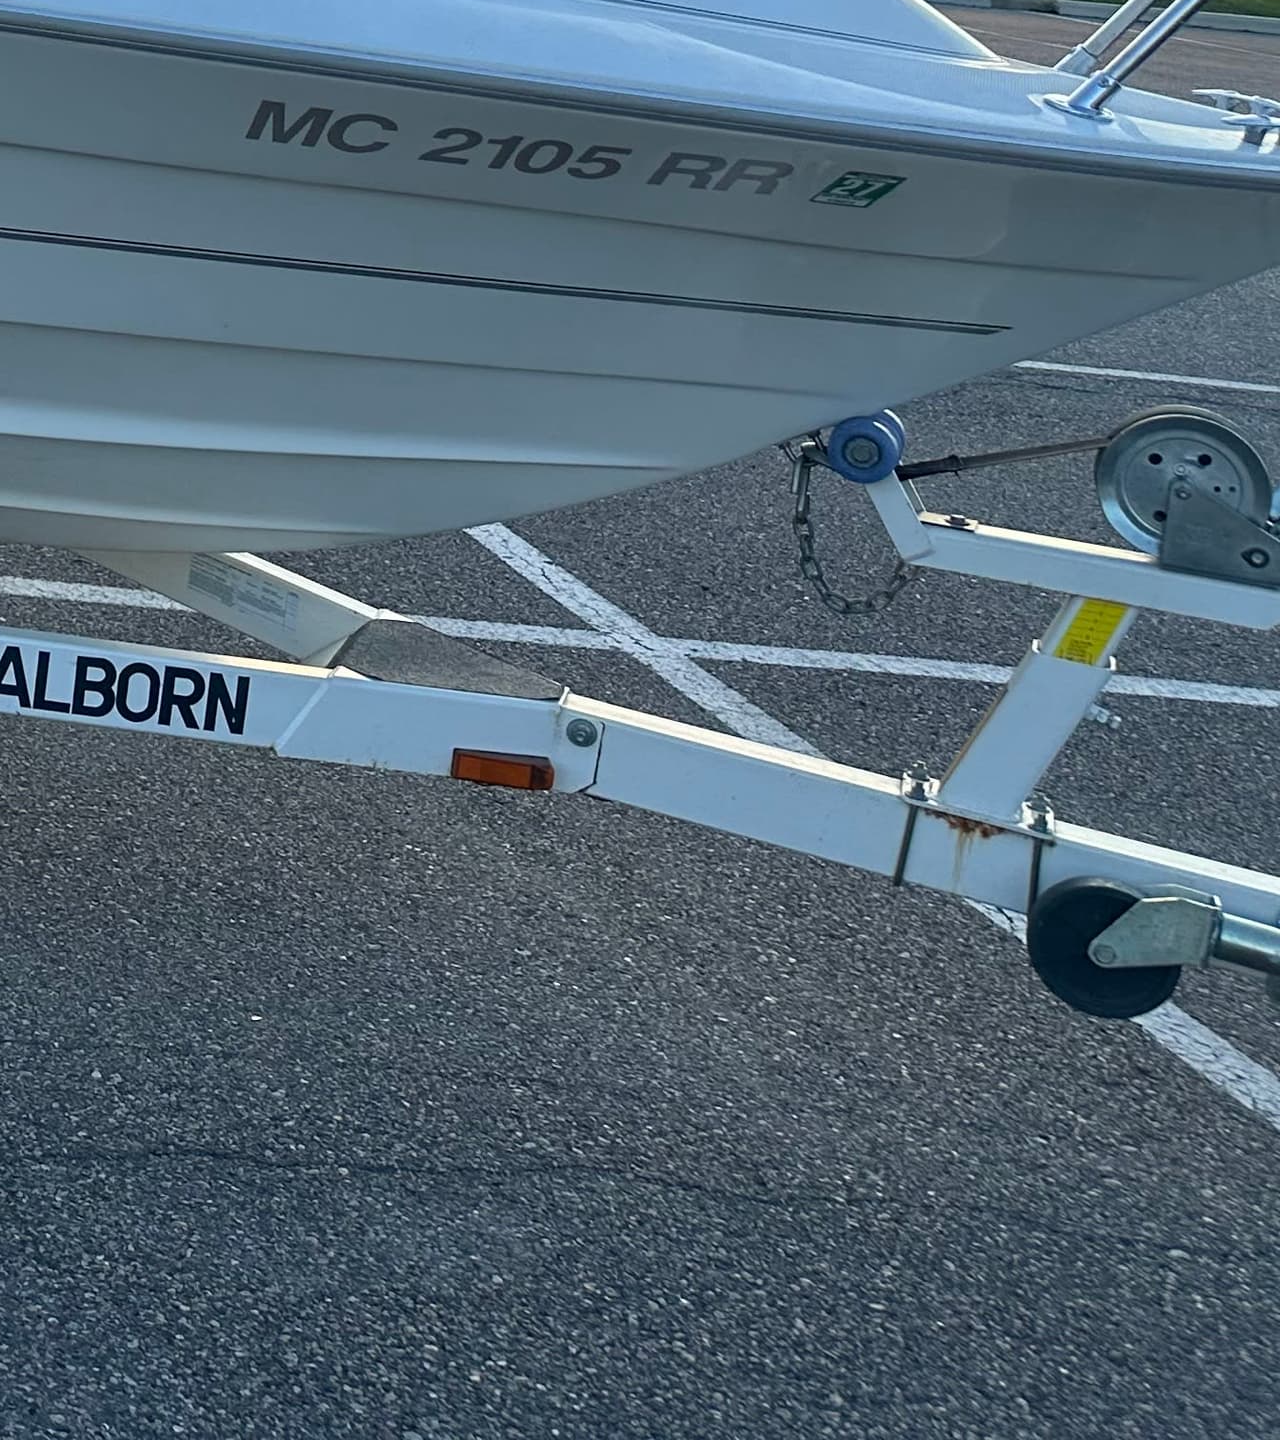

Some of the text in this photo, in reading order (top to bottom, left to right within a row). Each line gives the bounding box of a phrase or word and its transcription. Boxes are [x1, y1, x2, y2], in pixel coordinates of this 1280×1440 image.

[244, 98, 795, 196] MC 2105 RR
[830, 178, 887, 197] 27
